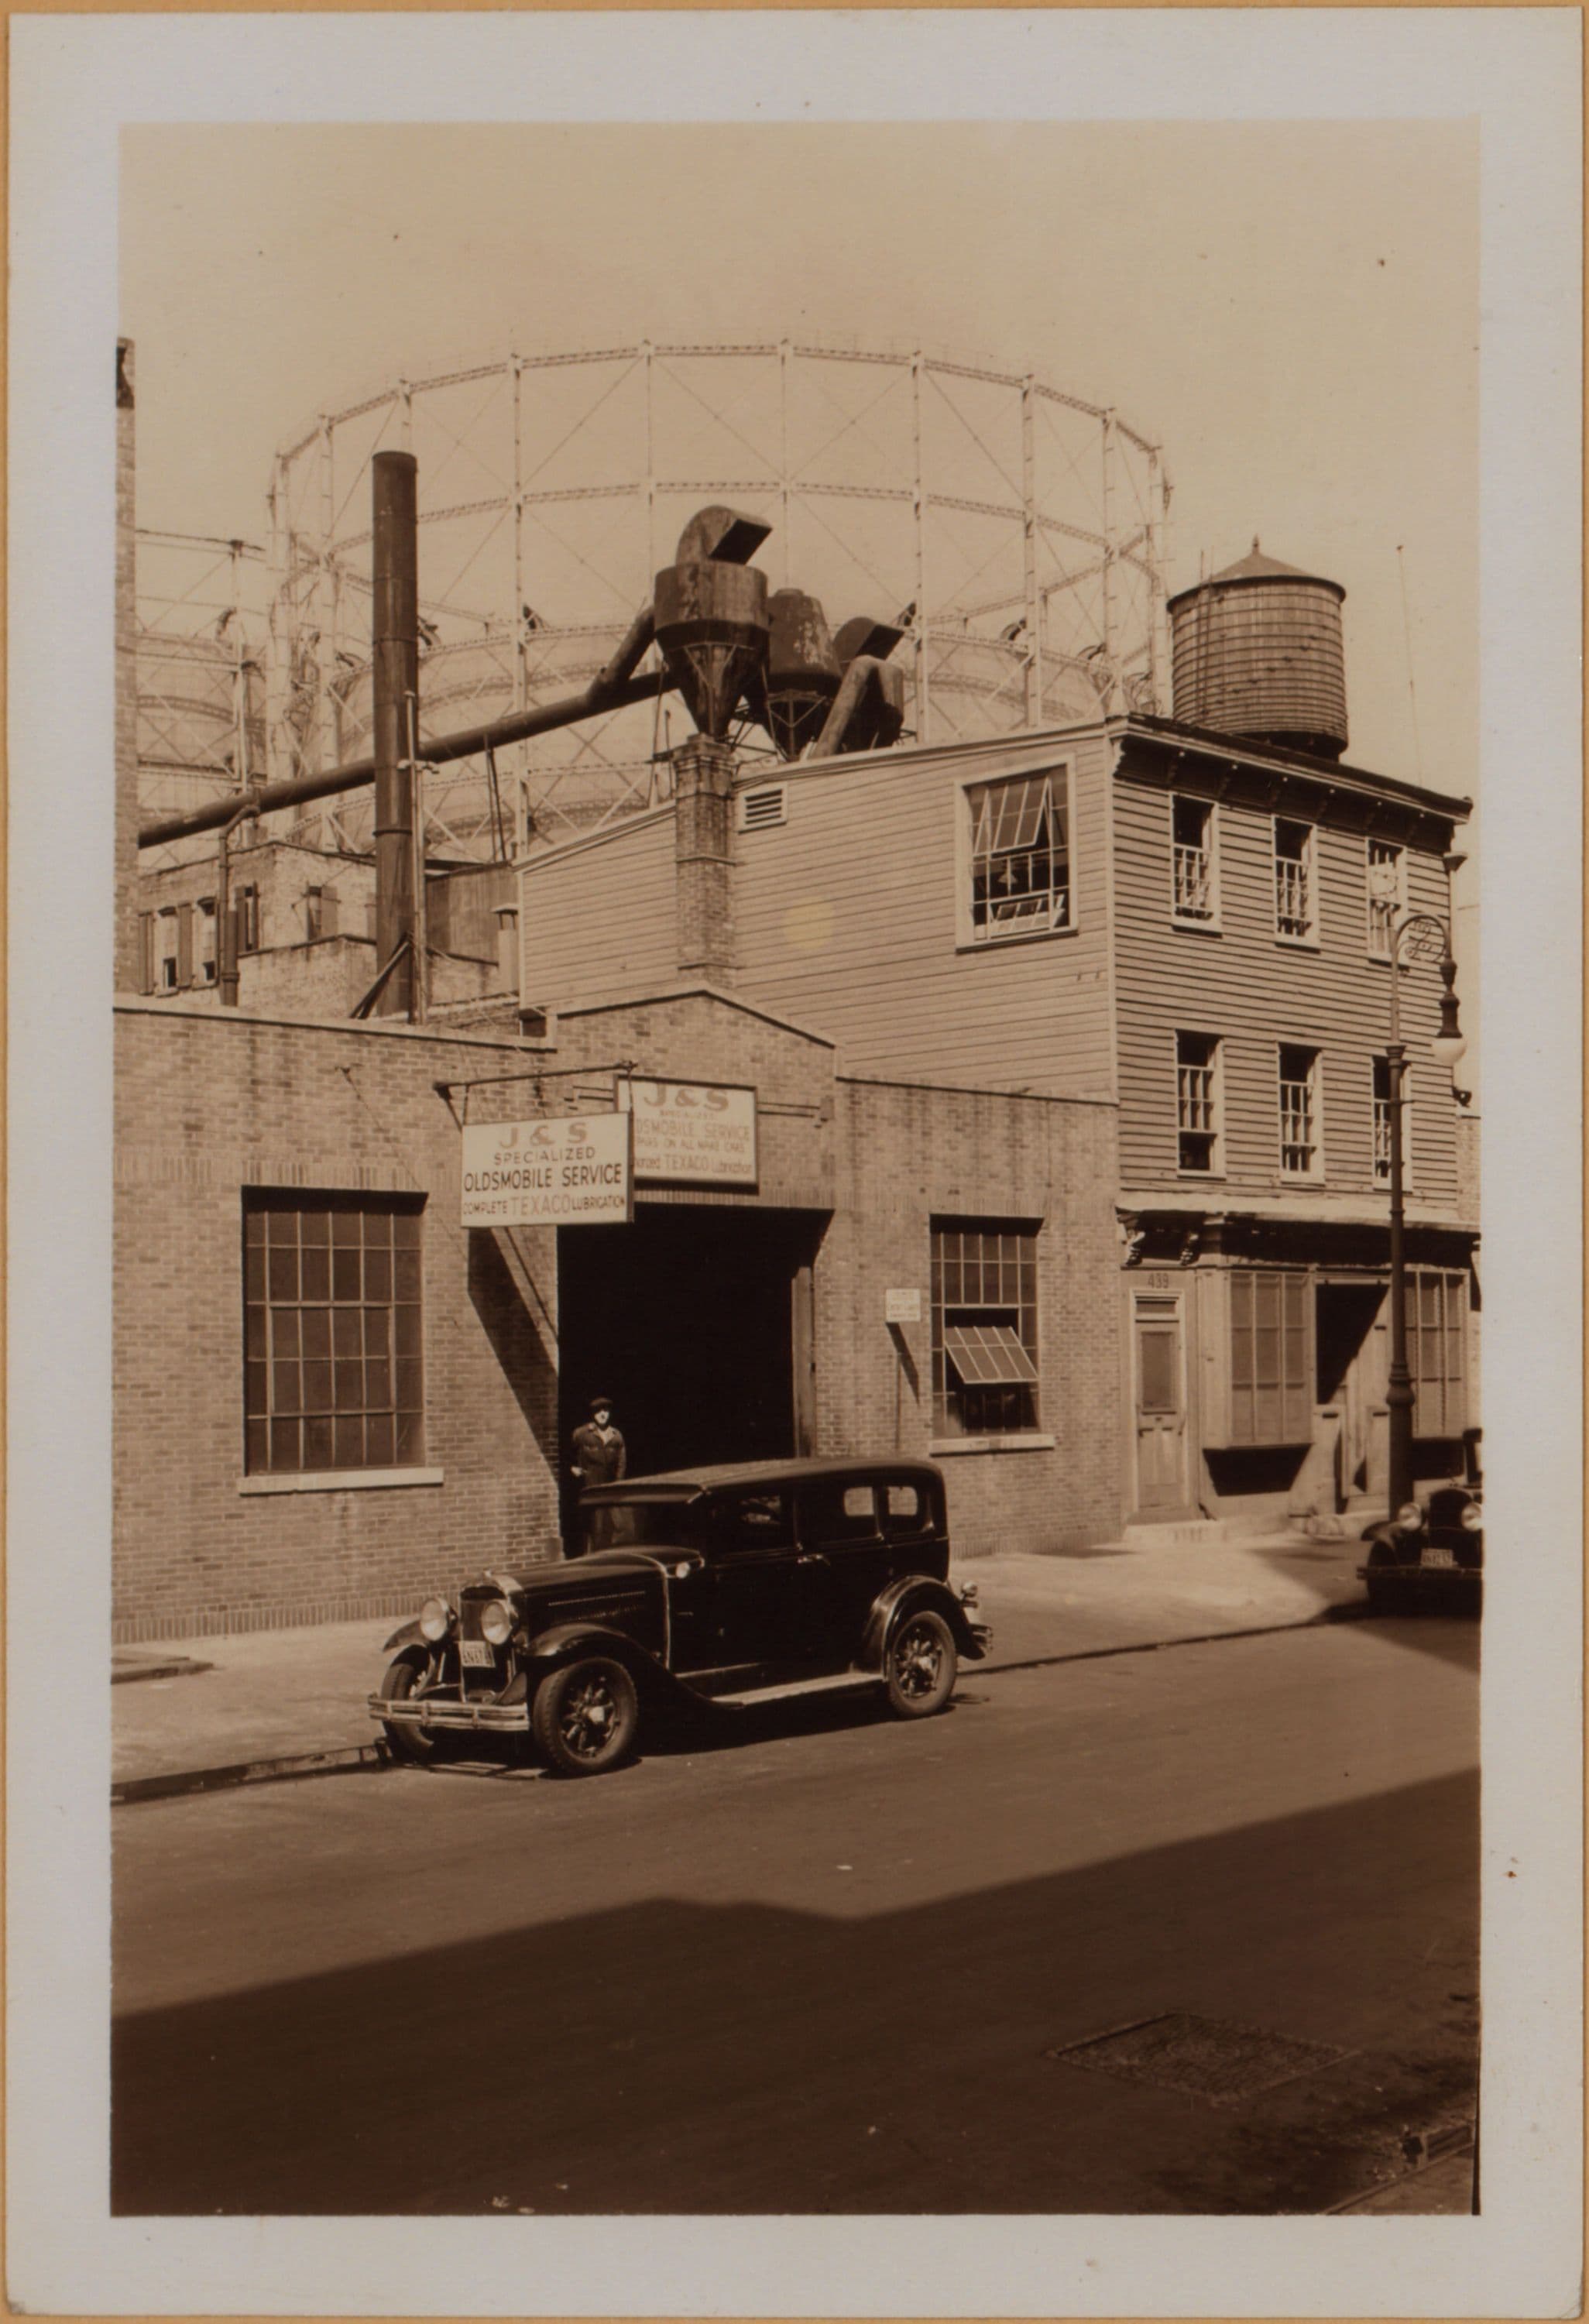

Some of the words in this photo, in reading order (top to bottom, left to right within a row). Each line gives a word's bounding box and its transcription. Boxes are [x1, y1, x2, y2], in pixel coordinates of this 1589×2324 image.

[644, 1083, 667, 1107] J
[674, 1088, 699, 1107] &
[702, 1089, 729, 1112] S
[499, 1127, 519, 1149] J
[530, 1125, 555, 1146] &
[567, 1122, 588, 1144] S
[636, 1117, 695, 1138] DSMOBILE
[704, 1123, 750, 1142] SERVICE
[494, 1146, 595, 1165] SPECIALIZED
[664, 1153, 709, 1171] TEXACO
[465, 1168, 553, 1192] OLDSMOBILE
[562, 1163, 622, 1187] SERVICE
[462, 1200, 508, 1215] COMPLETE
[511, 1194, 571, 1215] TEXACO
[571, 1195, 625, 1210] LUBRICATION
[1148, 1272, 1169, 1289] 439
